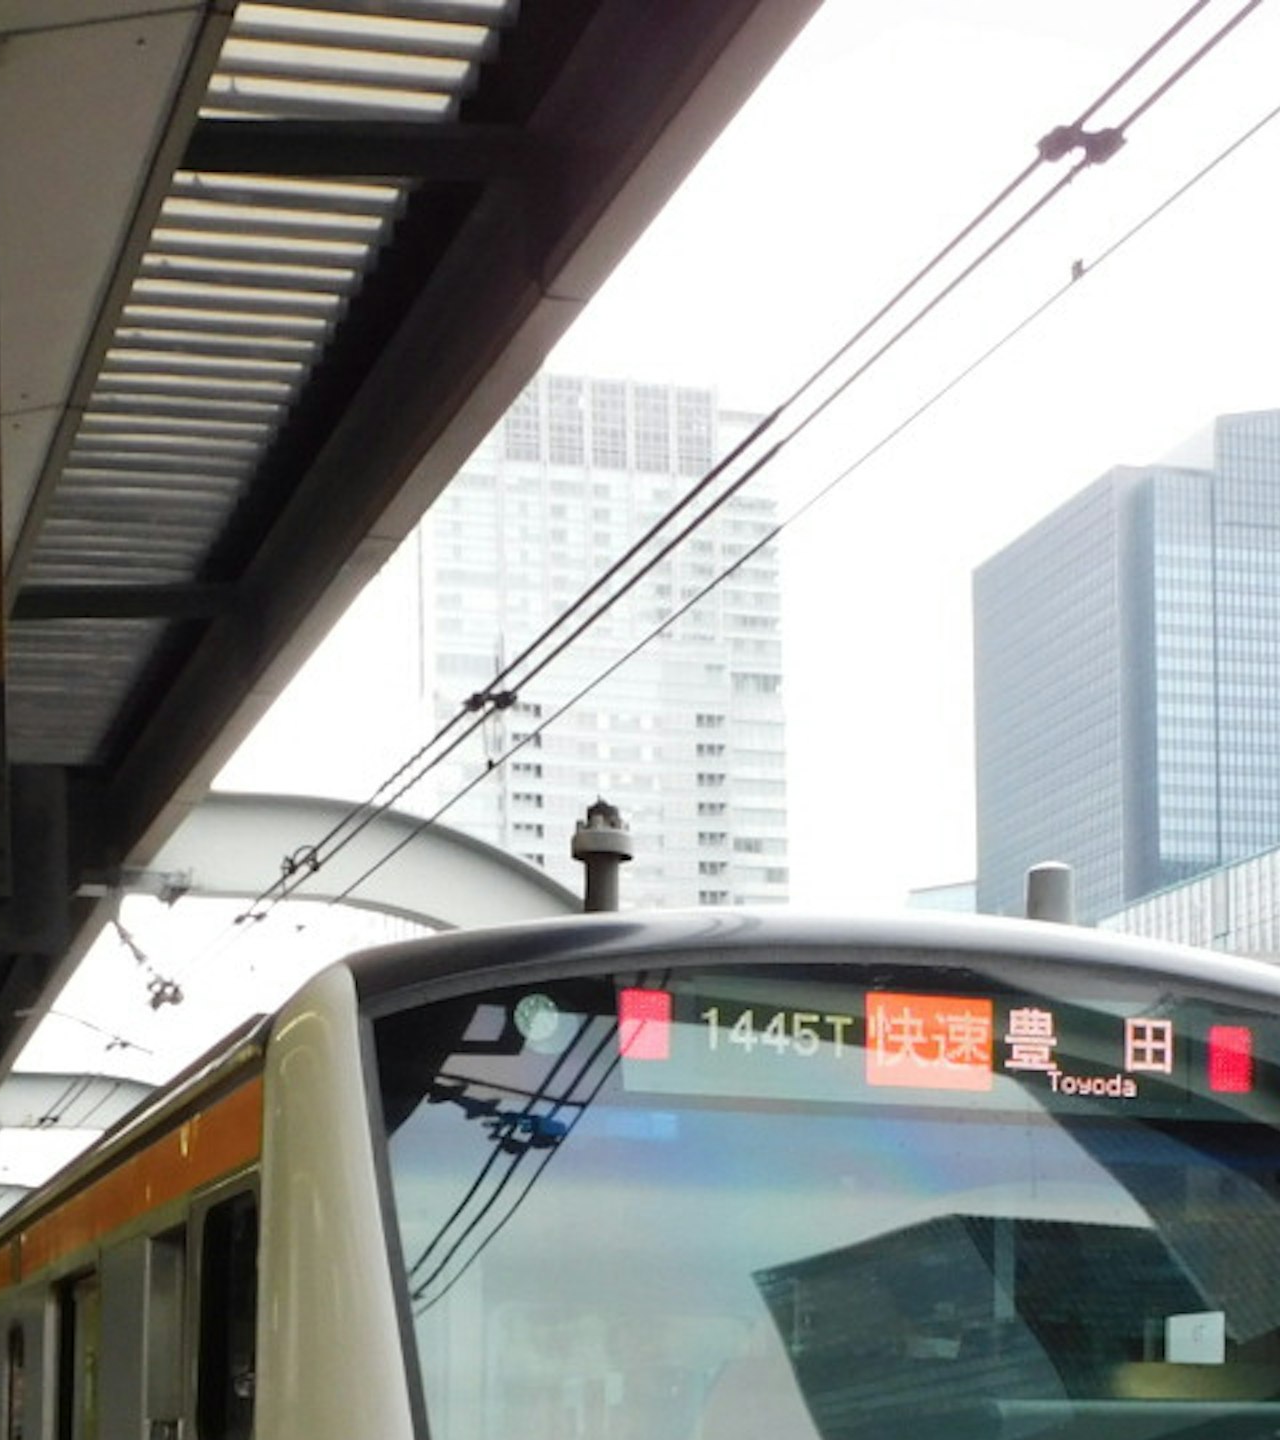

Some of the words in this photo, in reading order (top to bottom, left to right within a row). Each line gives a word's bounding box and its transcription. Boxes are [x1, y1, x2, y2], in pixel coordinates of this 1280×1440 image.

[701, 1006, 854, 1058] 1445T
[870, 1004, 990, 1068] 快速
[1047, 1070, 1137, 1098] Toyoda
